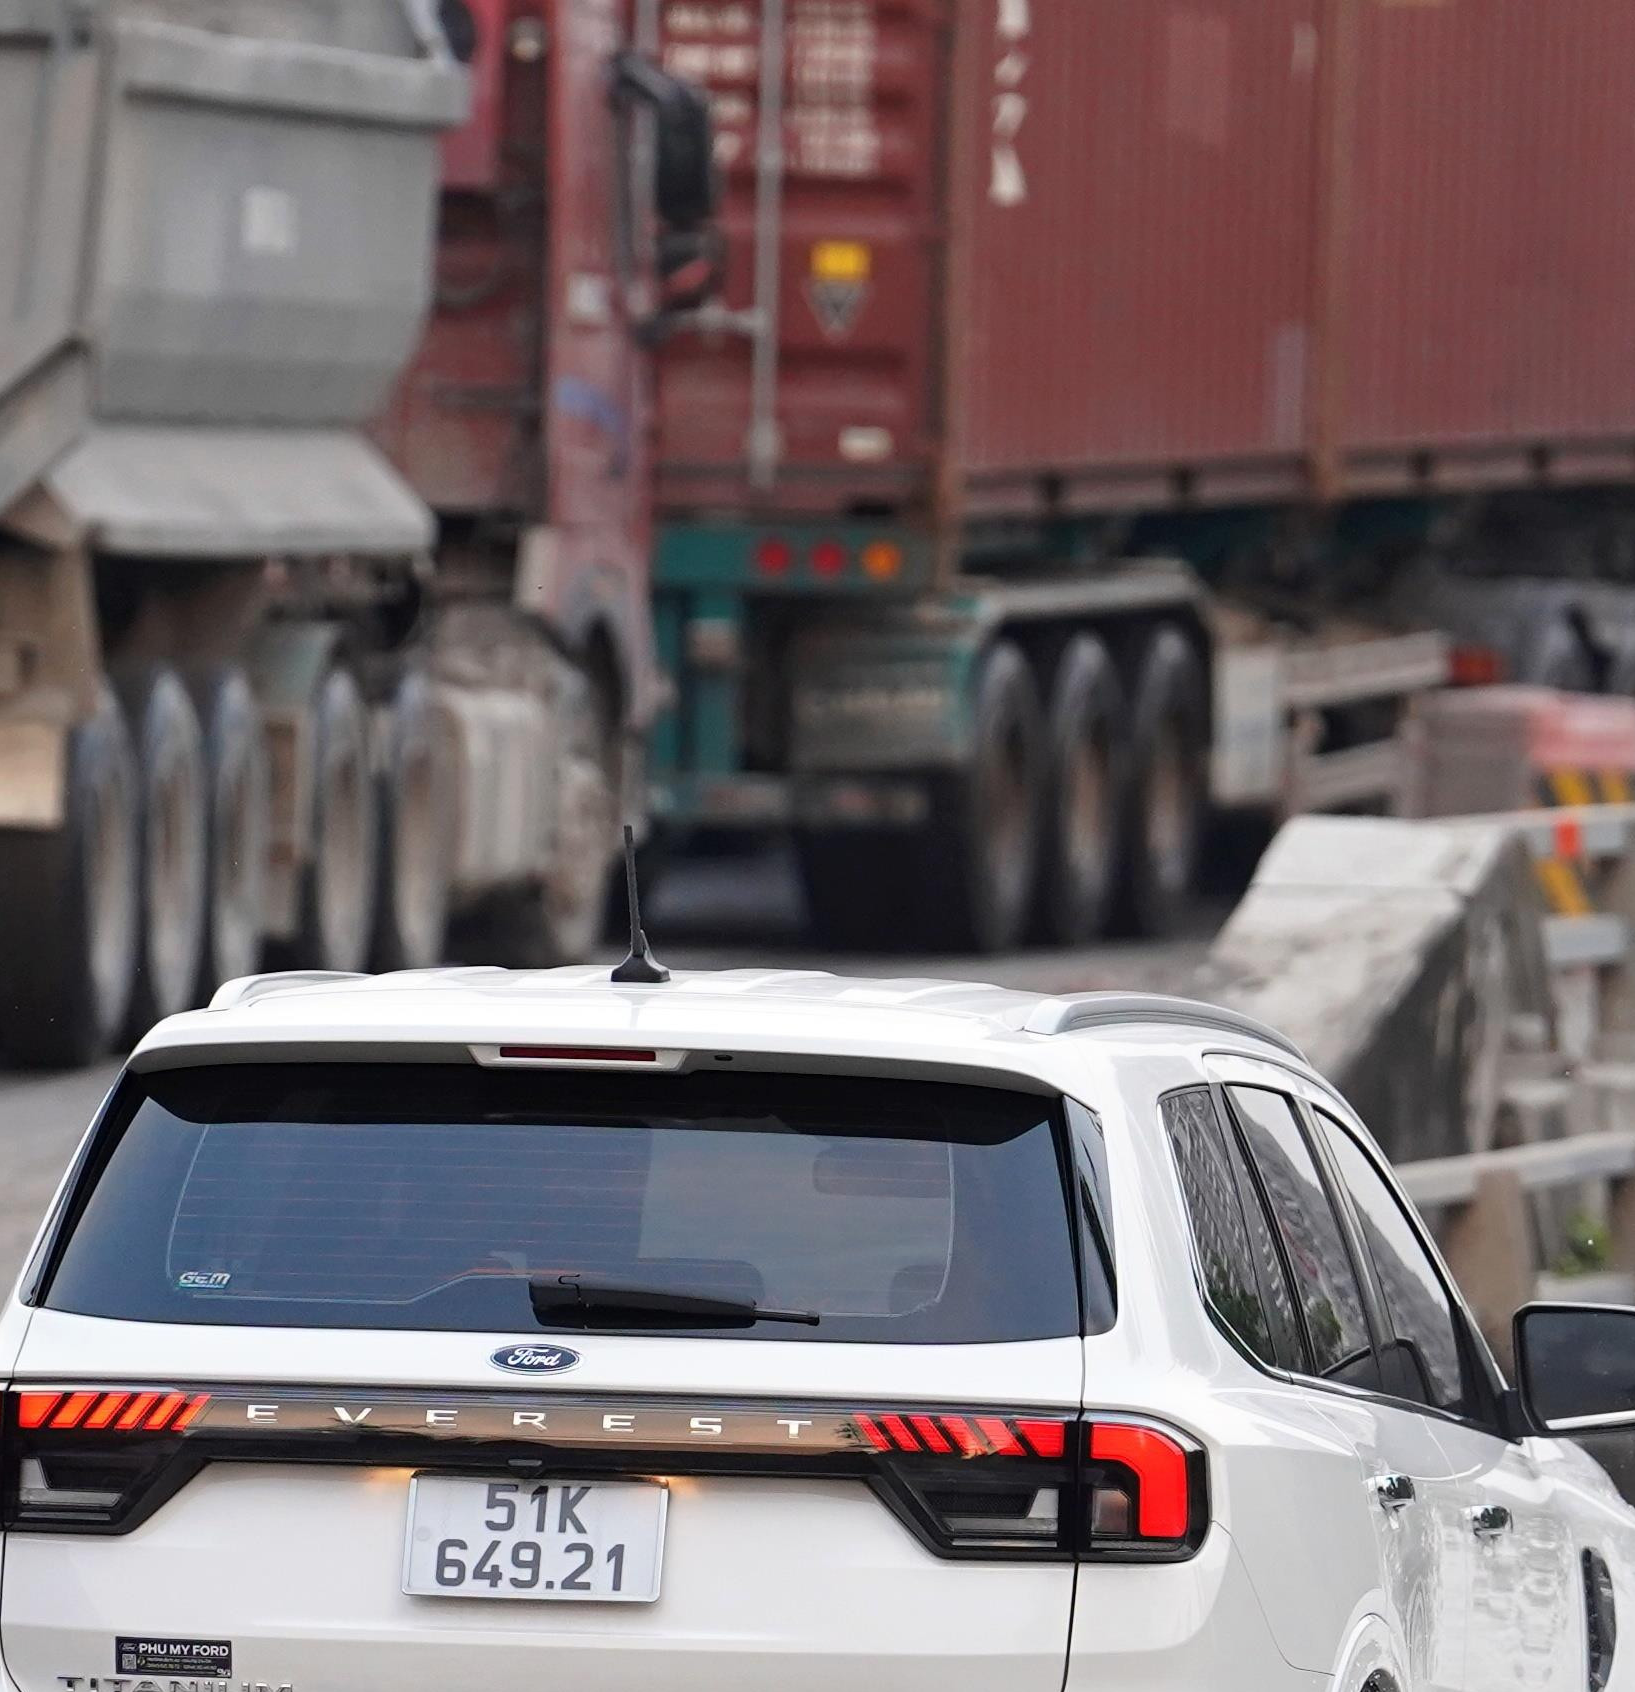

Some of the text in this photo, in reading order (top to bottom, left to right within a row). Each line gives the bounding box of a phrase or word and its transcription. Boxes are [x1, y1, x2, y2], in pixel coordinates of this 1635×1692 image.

[507, 1347, 562, 1366] Ford
[246, 1403, 814, 1440] EVEREST
[484, 1483, 592, 1535] 51K
[435, 1538, 626, 1592] 649.21
[138, 1643, 167, 1655] PHU
[169, 1644, 191, 1656] MY
[192, 1645, 229, 1657] FORD
